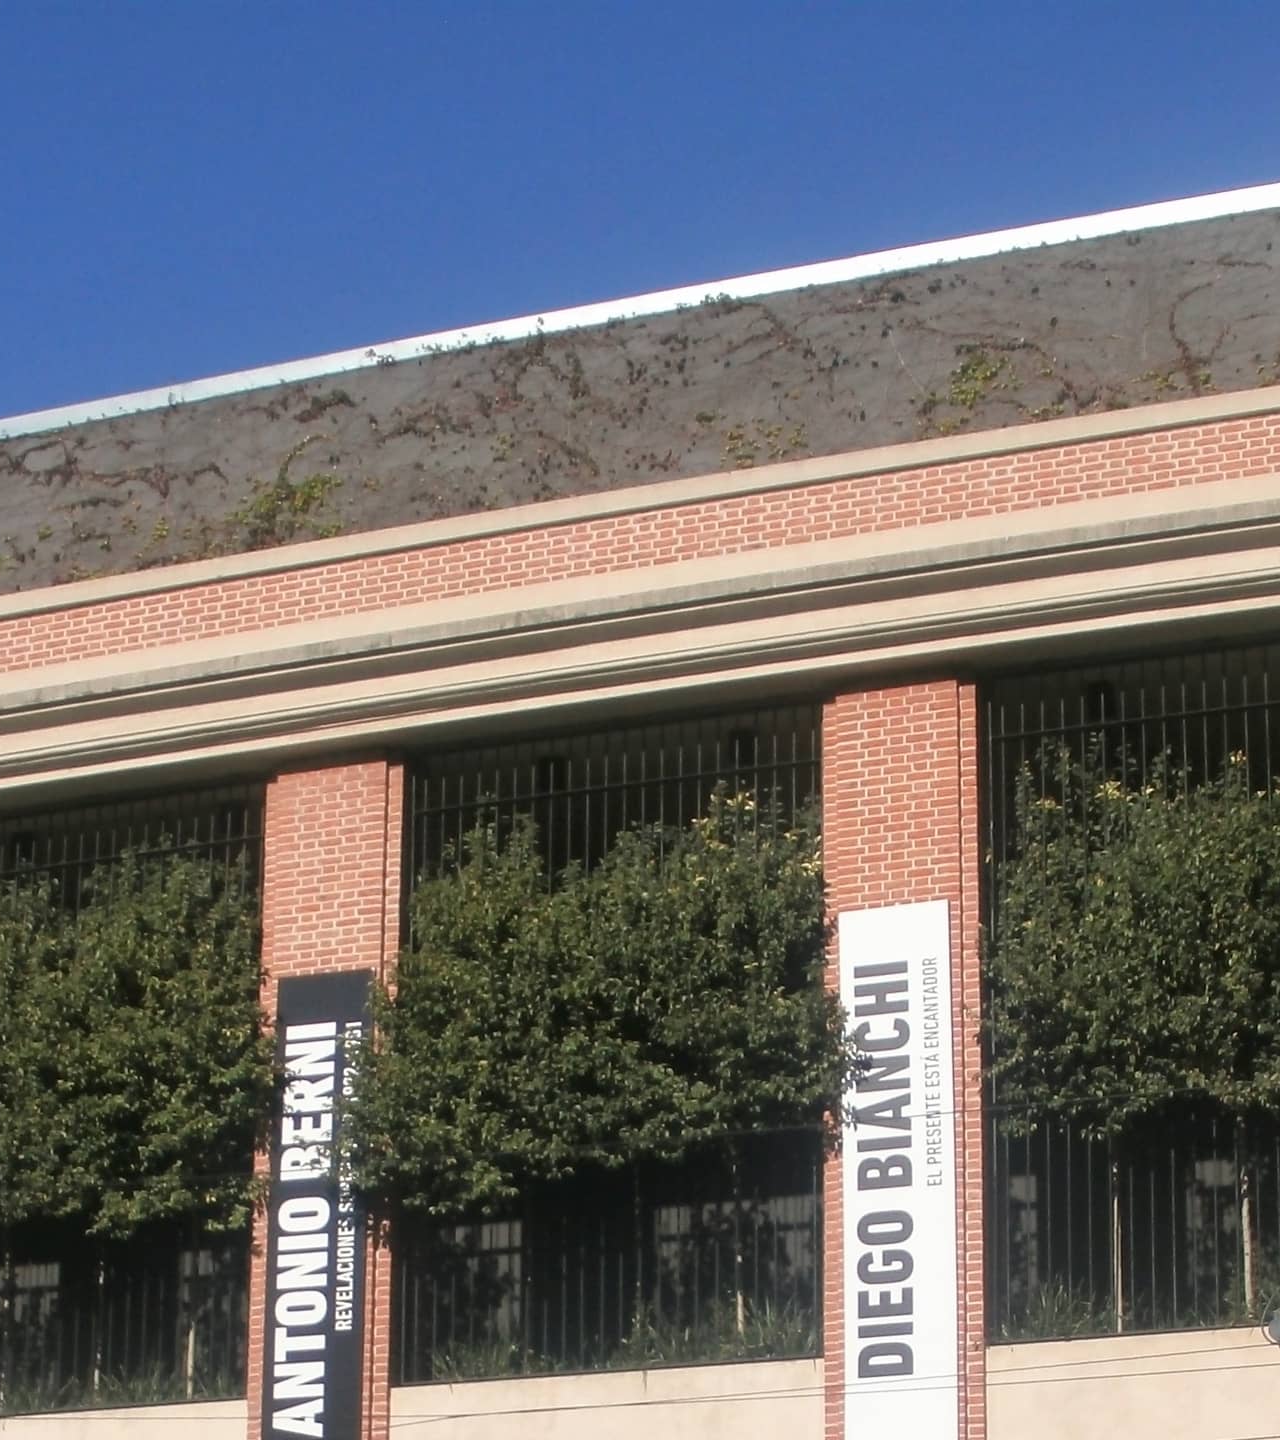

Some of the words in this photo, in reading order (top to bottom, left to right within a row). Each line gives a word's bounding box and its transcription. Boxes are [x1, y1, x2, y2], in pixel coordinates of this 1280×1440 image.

[922, 956, 940, 1049] ENCANTADOR
[280, 1021, 337, 1181] BERNI
[853, 960, 913, 1191] BIANCHI
[920, 1052, 941, 1090] ESTÁ
[925, 1092, 942, 1168] PRESENTE
[927, 1170, 942, 1188] EL
[272, 1197, 331, 1439] ANTONIO
[857, 1209, 914, 1379] DIEGO
